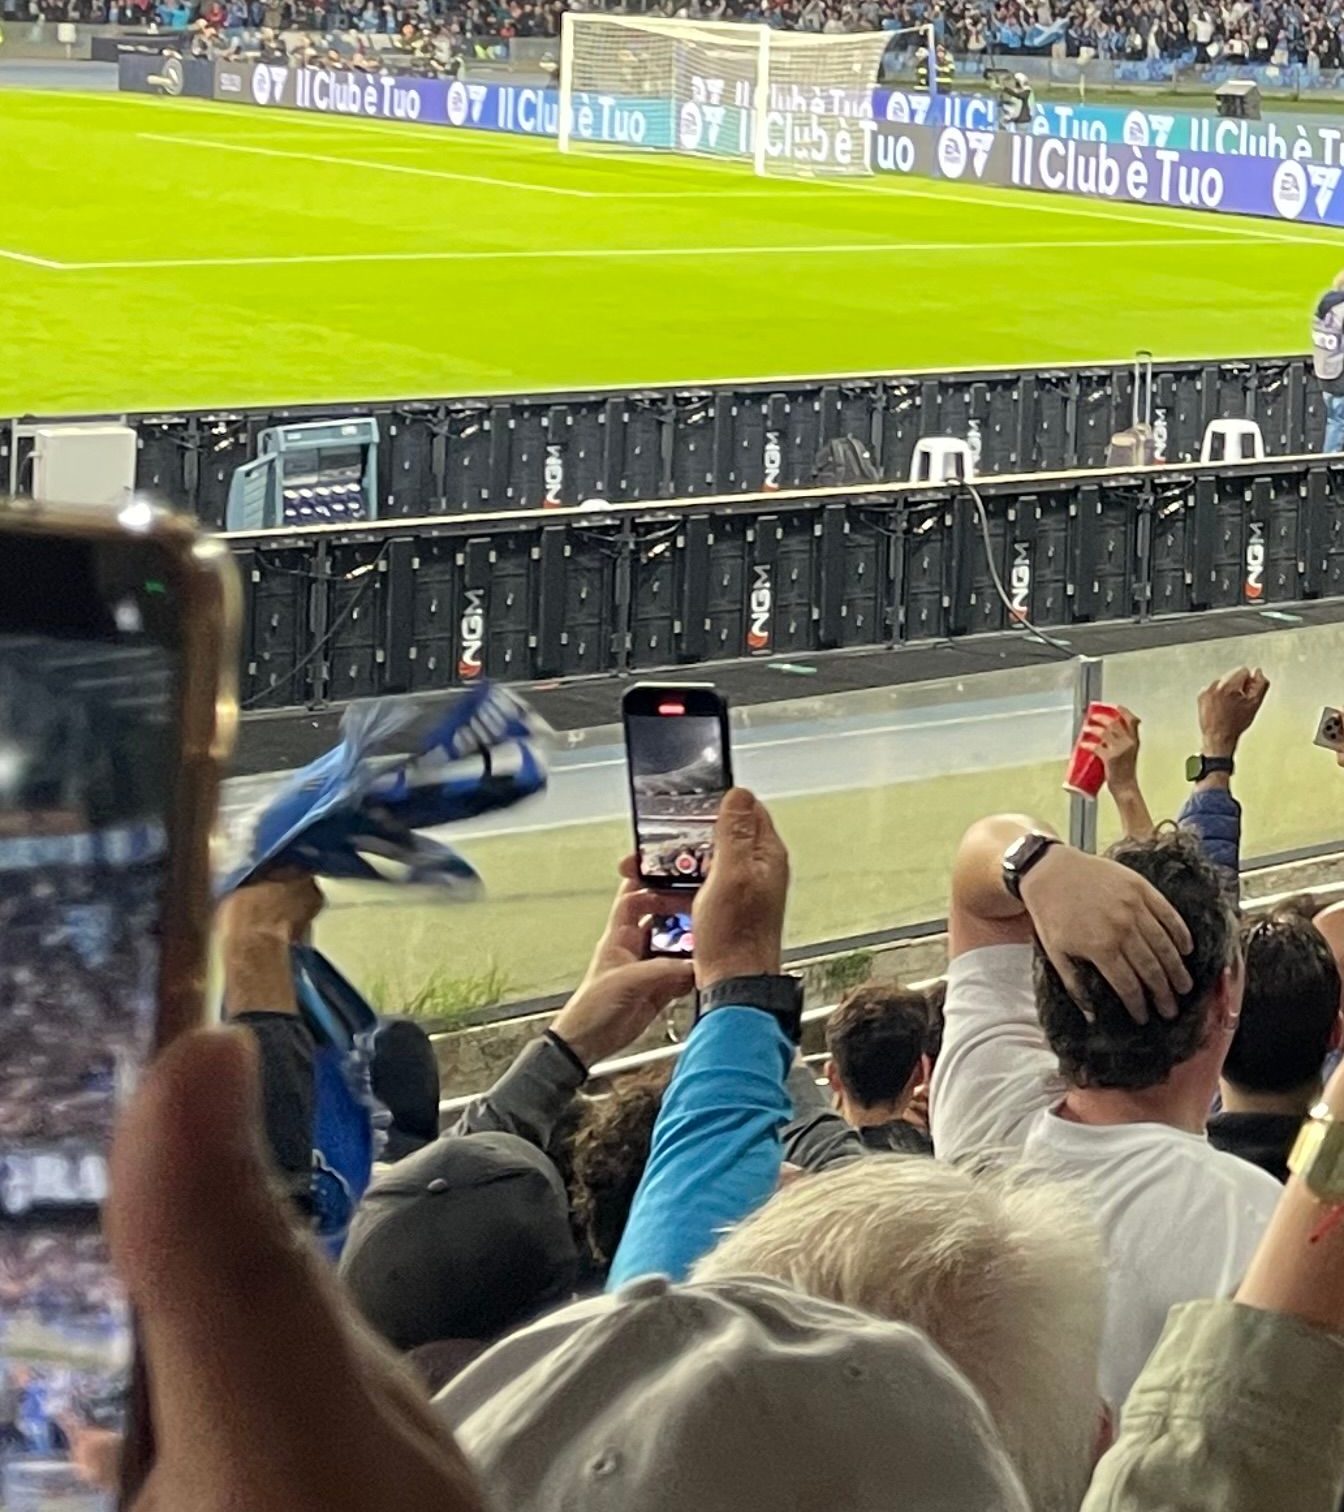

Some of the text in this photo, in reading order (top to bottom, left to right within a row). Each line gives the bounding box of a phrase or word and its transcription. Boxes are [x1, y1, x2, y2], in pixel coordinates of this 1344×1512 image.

[313, 70, 361, 114] Club
[363, 76, 378, 115] è
[380, 76, 422, 120] Tuo
[498, 87, 513, 130] Il
[517, 90, 570, 135] Clu
[598, 96, 646, 143] Tuo
[858, 120, 914, 173] Tuo
[1053, 106, 1108, 142] Tuo
[1214, 119, 1288, 159] Club
[1292, 124, 1312, 160] è
[1011, 135, 1225, 208] Il Club è Tuo
[544, 444, 563, 501] NGM
[763, 431, 782, 487] NGM
[1010, 542, 1030, 612] NGM
[1246, 521, 1264, 585] NGM
[461, 589, 486, 666] NGM
[750, 564, 772, 637] NGM
